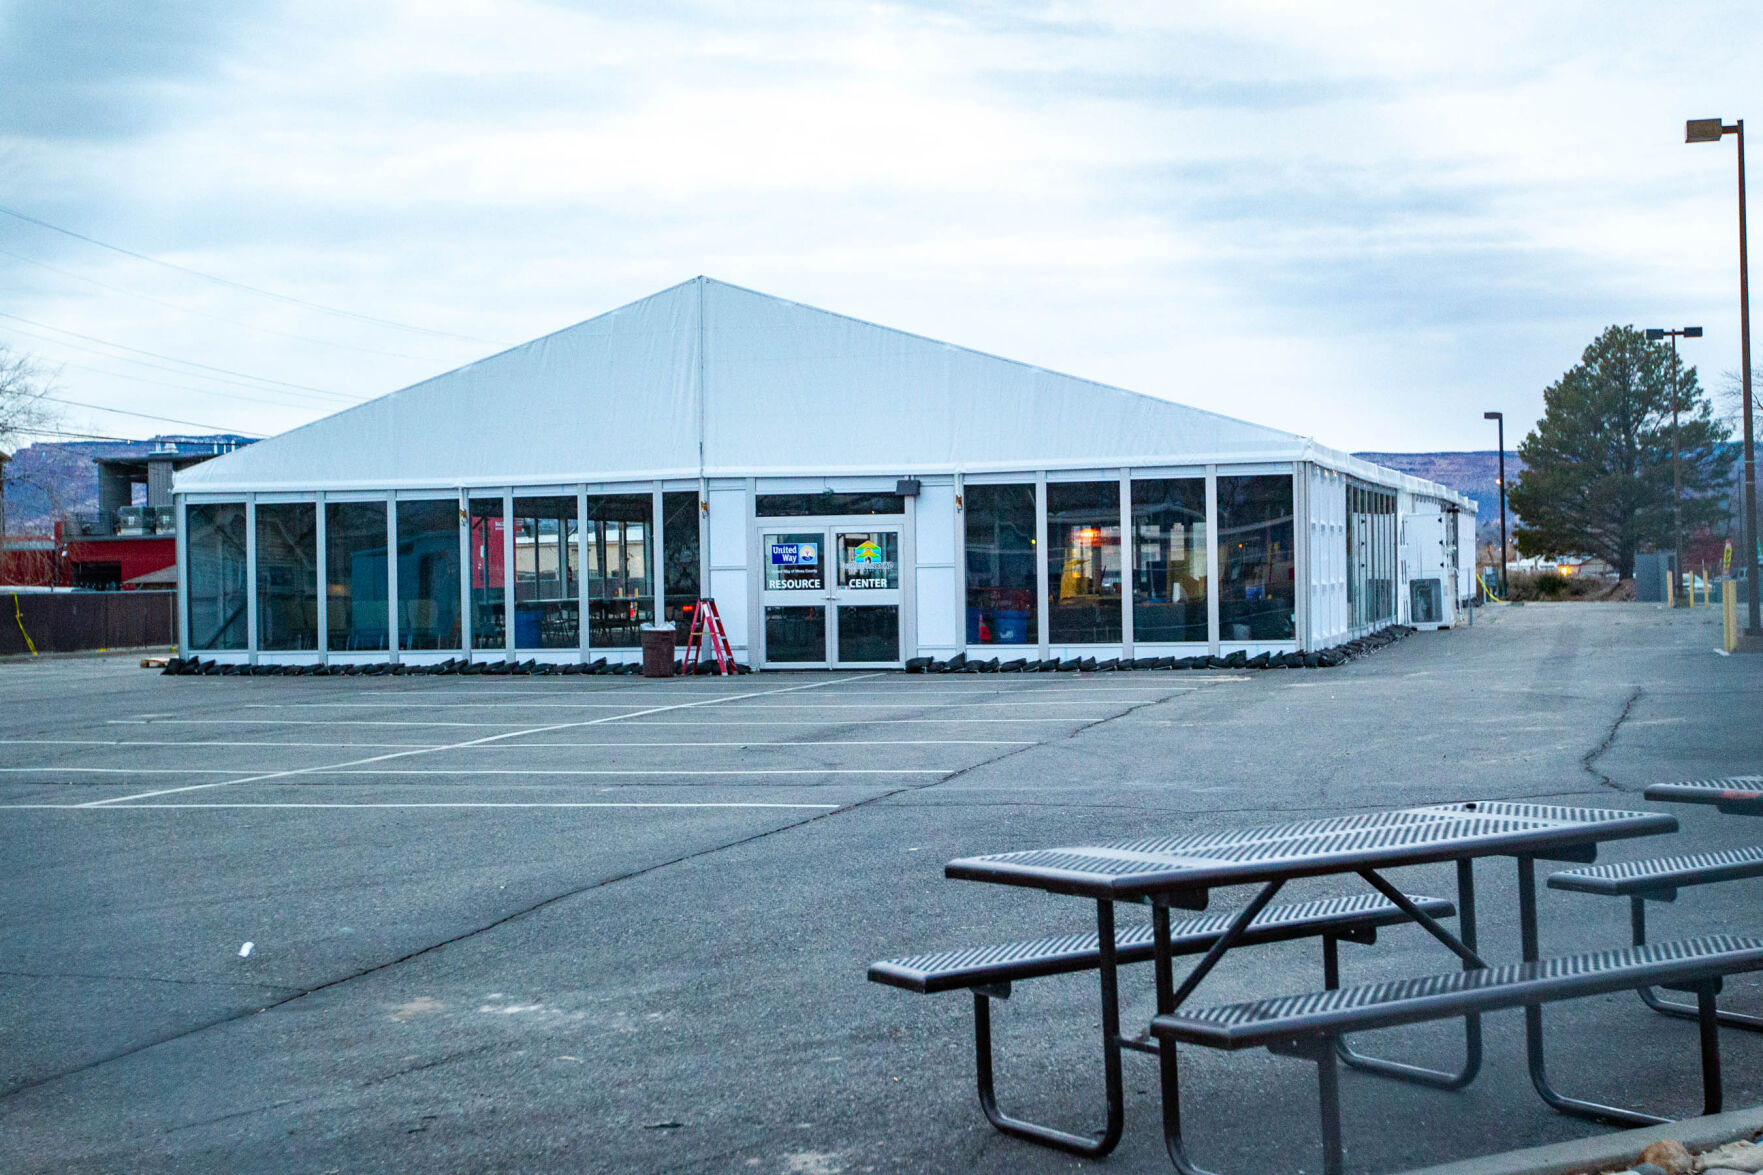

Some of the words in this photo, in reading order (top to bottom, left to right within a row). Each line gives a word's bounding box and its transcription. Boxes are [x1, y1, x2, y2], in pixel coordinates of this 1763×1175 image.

[773, 546, 797, 554] United
[782, 554, 797, 565] Way
[769, 579, 820, 589] RESOURCE
[849, 579, 888, 588] CENTER
